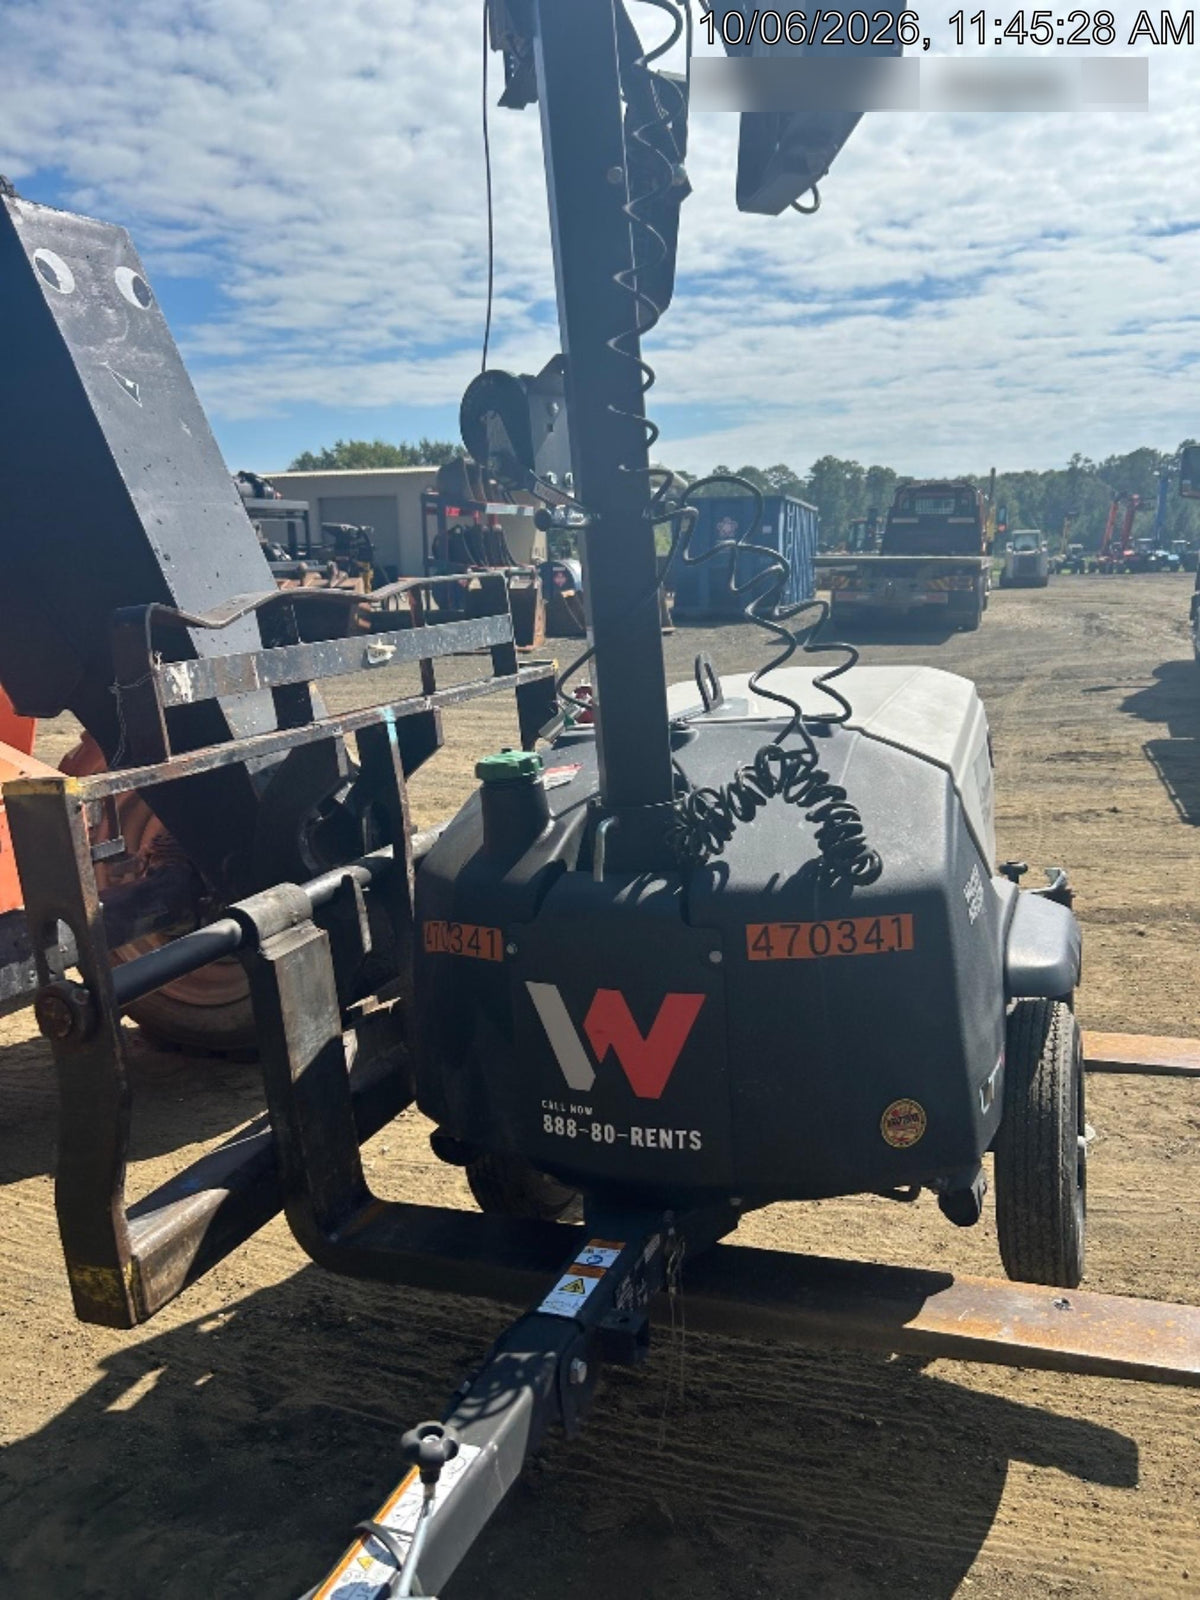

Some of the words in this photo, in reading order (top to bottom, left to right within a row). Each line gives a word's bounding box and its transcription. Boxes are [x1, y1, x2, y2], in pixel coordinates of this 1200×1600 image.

[752, 917, 903, 957] 470341
[541, 1100, 566, 1112] CALL
[570, 1104, 593, 1115] NOW
[543, 1114, 703, 1151] 888-80-RENTS
